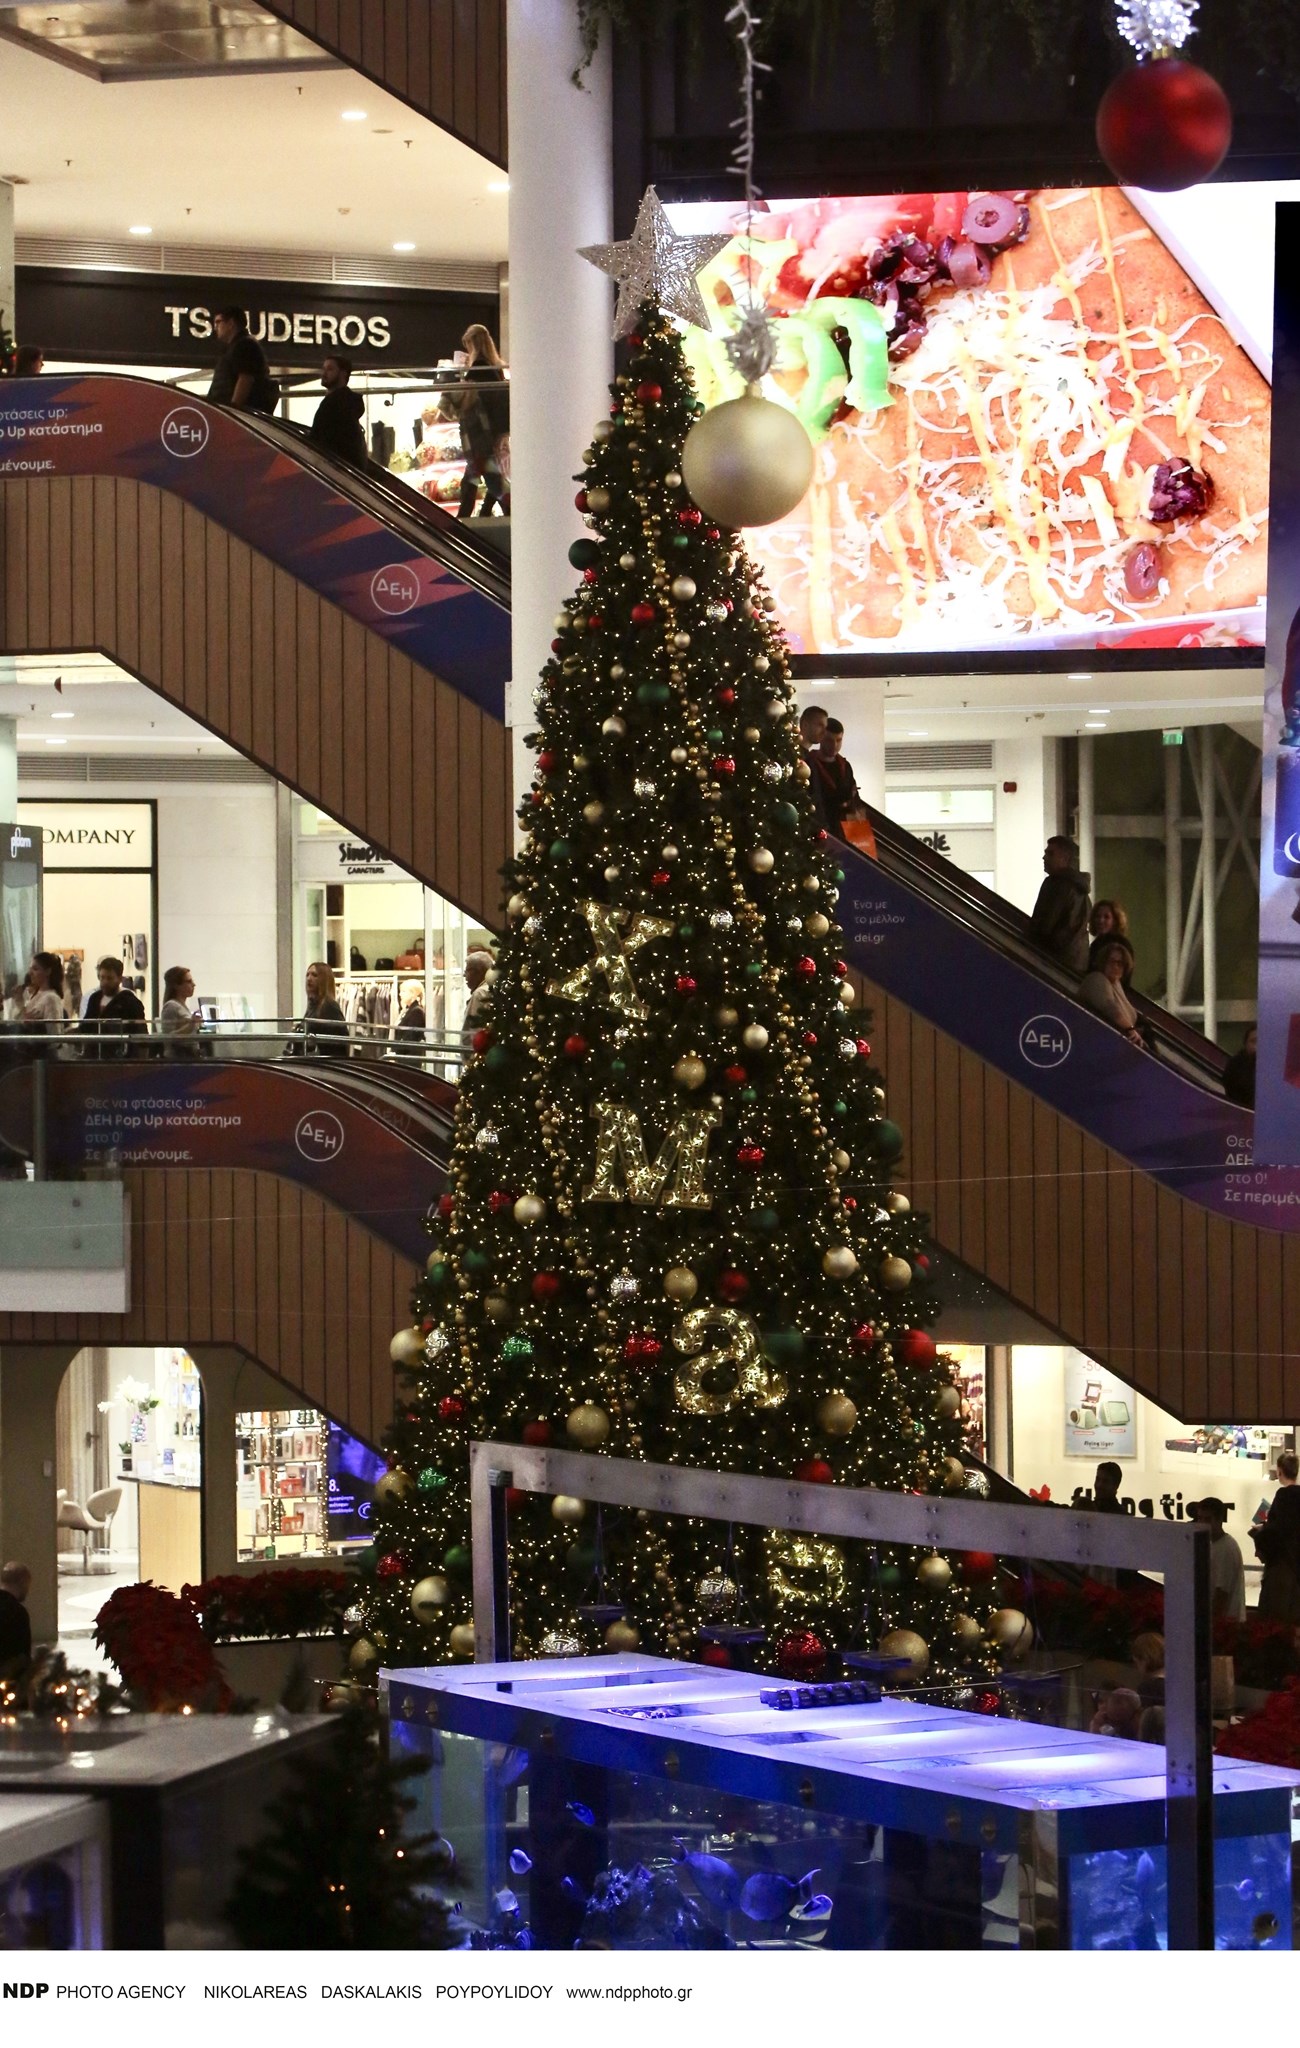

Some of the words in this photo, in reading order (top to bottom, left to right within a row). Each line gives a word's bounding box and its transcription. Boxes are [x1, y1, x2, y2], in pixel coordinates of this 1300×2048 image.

[164, 306, 391, 348] TSUDEROS
[7, 425, 26, 439] Up
[29, 422, 103, 437] κατάστημα
[875, 901, 887, 910] με
[854, 915, 867, 924] το
[869, 914, 906, 925] μέλλον
[854, 932, 885, 945] dei.gr
[131, 1098, 182, 1111] φτάσεις
[116, 1114, 141, 1128] Pop
[144, 1114, 163, 1128] Up
[166, 1113, 242, 1128] κατάστημα
[1226, 1135, 1253, 1149] Θες
[1225, 1173, 1251, 1184] στο
[1224, 1189, 1241, 1202] Σε
[328, 1479, 340, 1492] 8.
